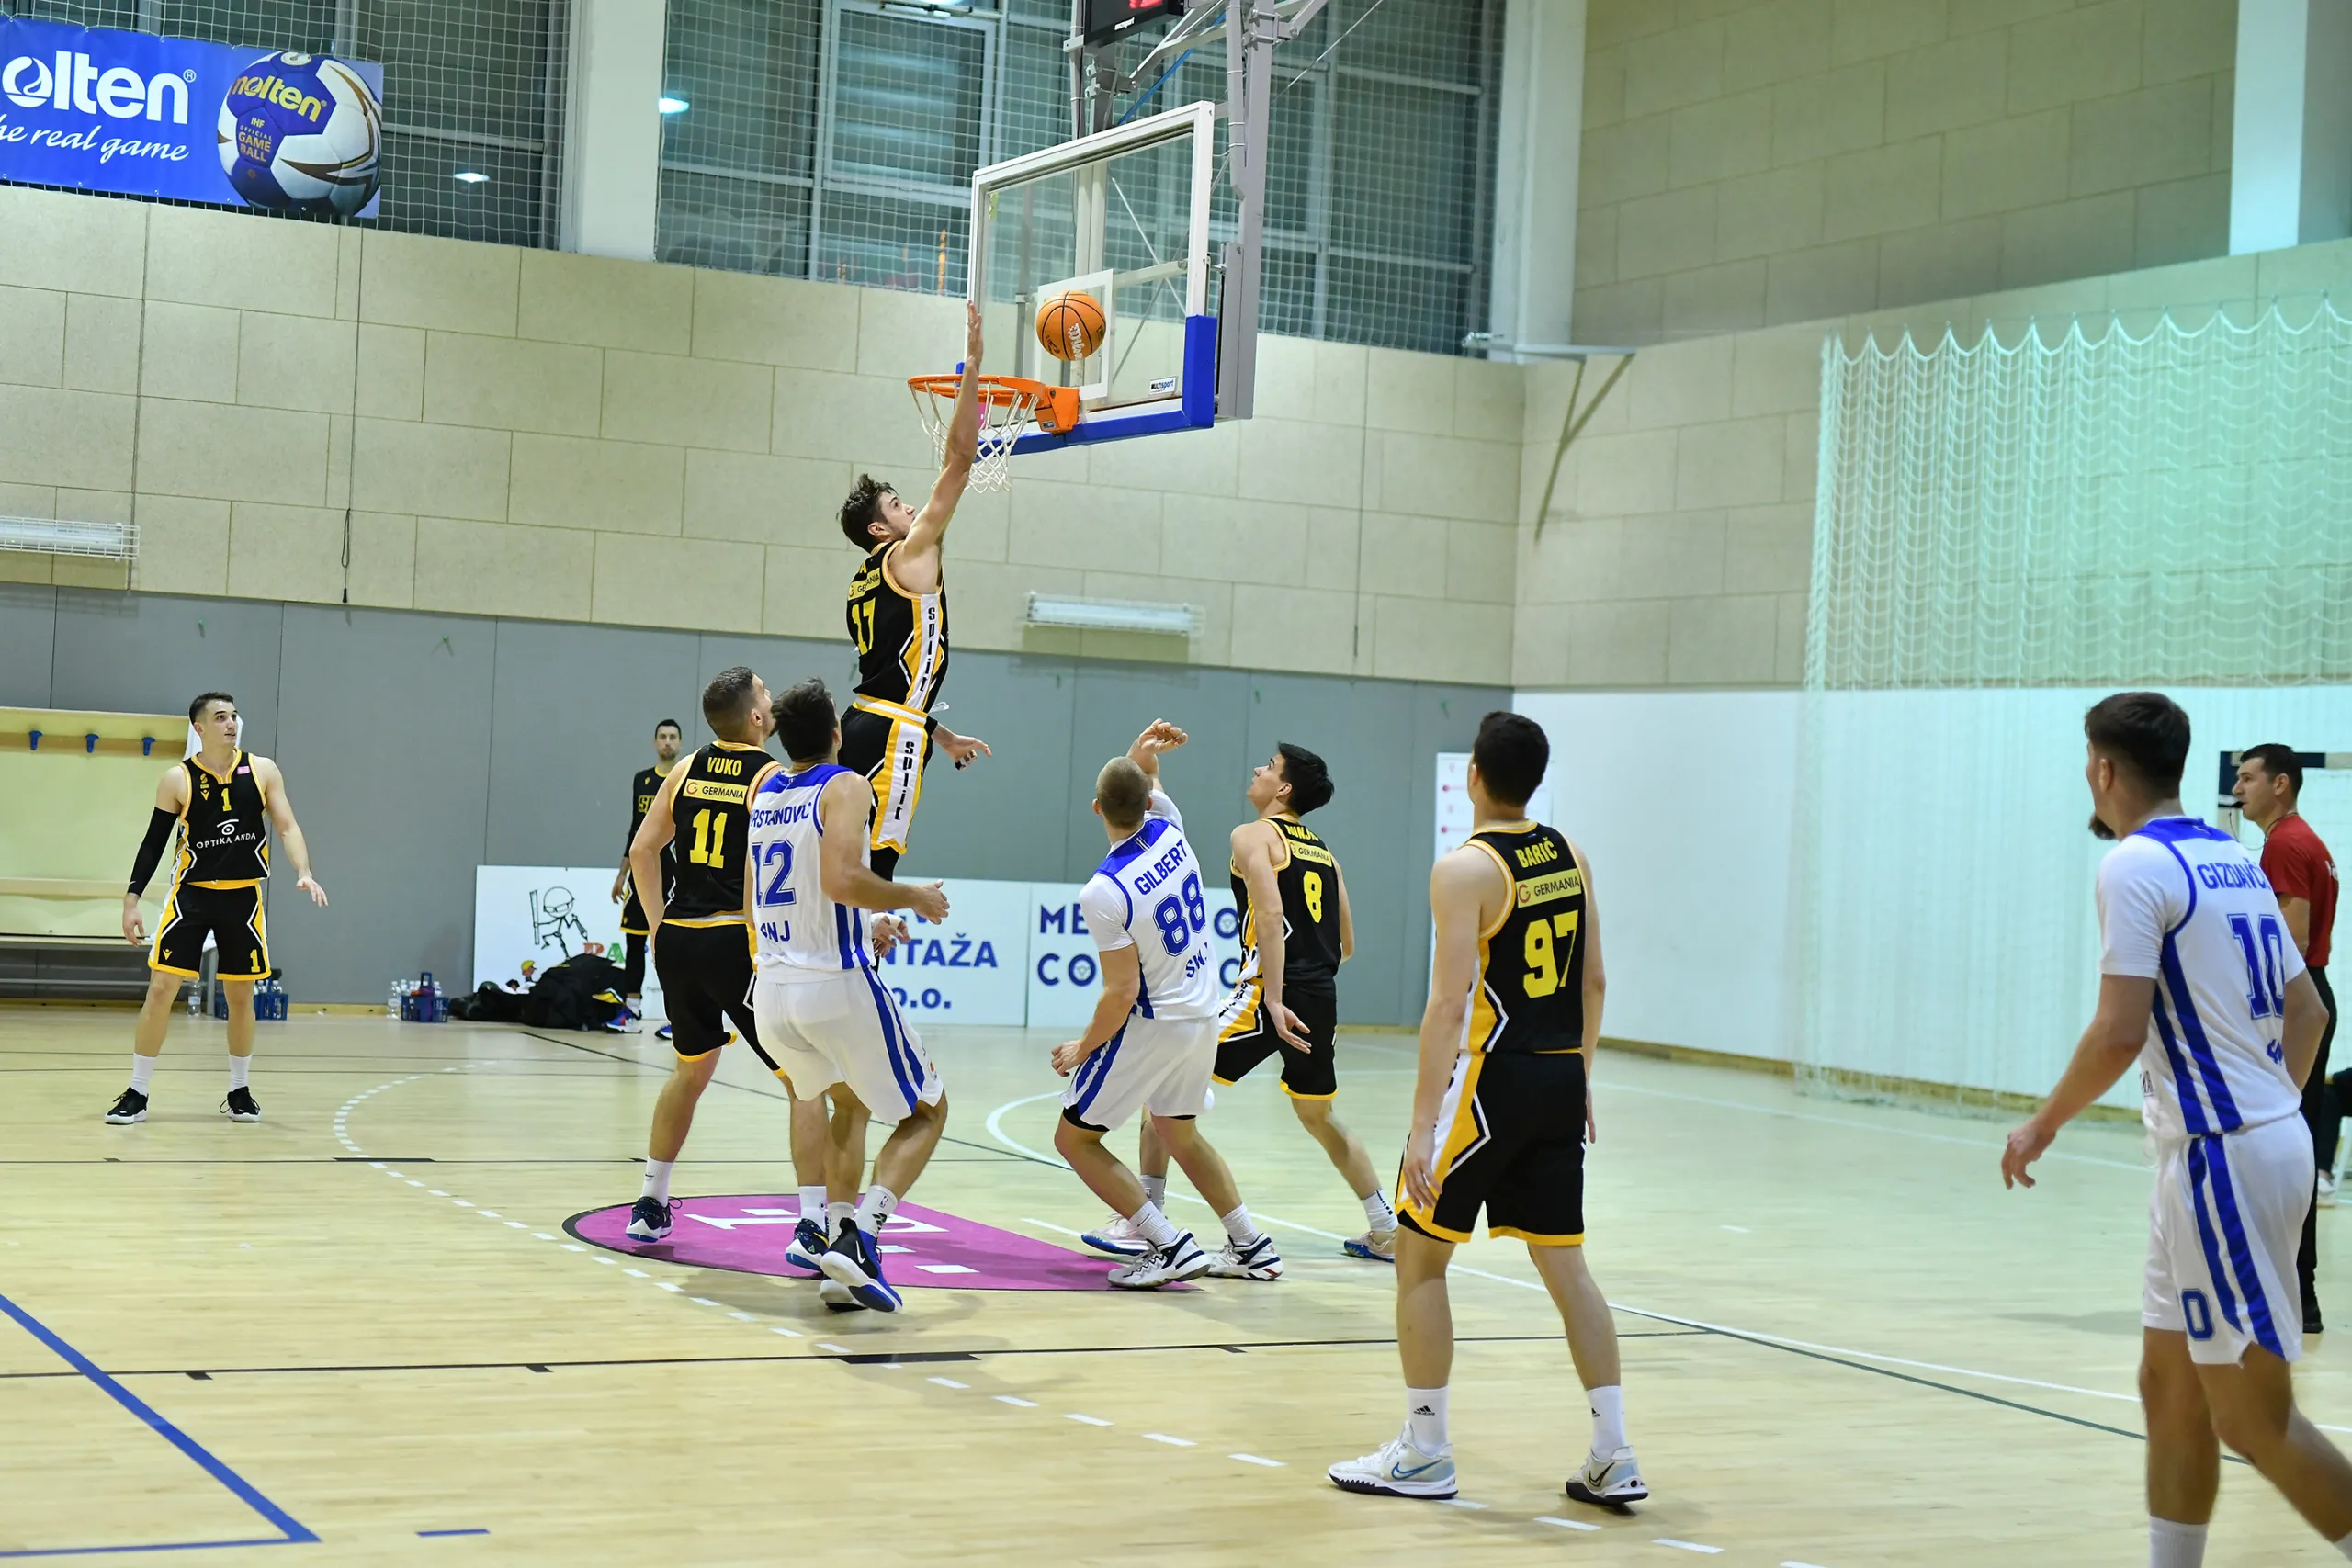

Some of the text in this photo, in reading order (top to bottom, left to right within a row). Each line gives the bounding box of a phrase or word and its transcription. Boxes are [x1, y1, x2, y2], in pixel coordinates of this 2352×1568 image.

[2, 50, 189, 125] olten
[0, 113, 189, 164] he real game
[238, 131, 272, 152] GAME
[239, 125, 273, 141] OFFICIAL
[250, 117, 266, 129] IHF
[240, 143, 266, 162] BALL
[852, 597, 876, 656] 17
[701, 785, 744, 799] GERMANIA
[707, 757, 742, 776] VUKO
[221, 787, 232, 812] 1
[196, 832, 256, 849] OPTIKA ANDA
[690, 809, 728, 869] 11
[752, 839, 797, 908] 12
[1134, 840, 1188, 896] GILBERT
[1533, 875, 1580, 897] GERMANIA
[1153, 870, 1206, 957] 88
[1303, 870, 1323, 924] 8
[250, 949, 261, 973] 1
[1523, 909, 1579, 998] 97
[2226, 913, 2285, 1021] 10
[2181, 1288, 2216, 1342] 0
